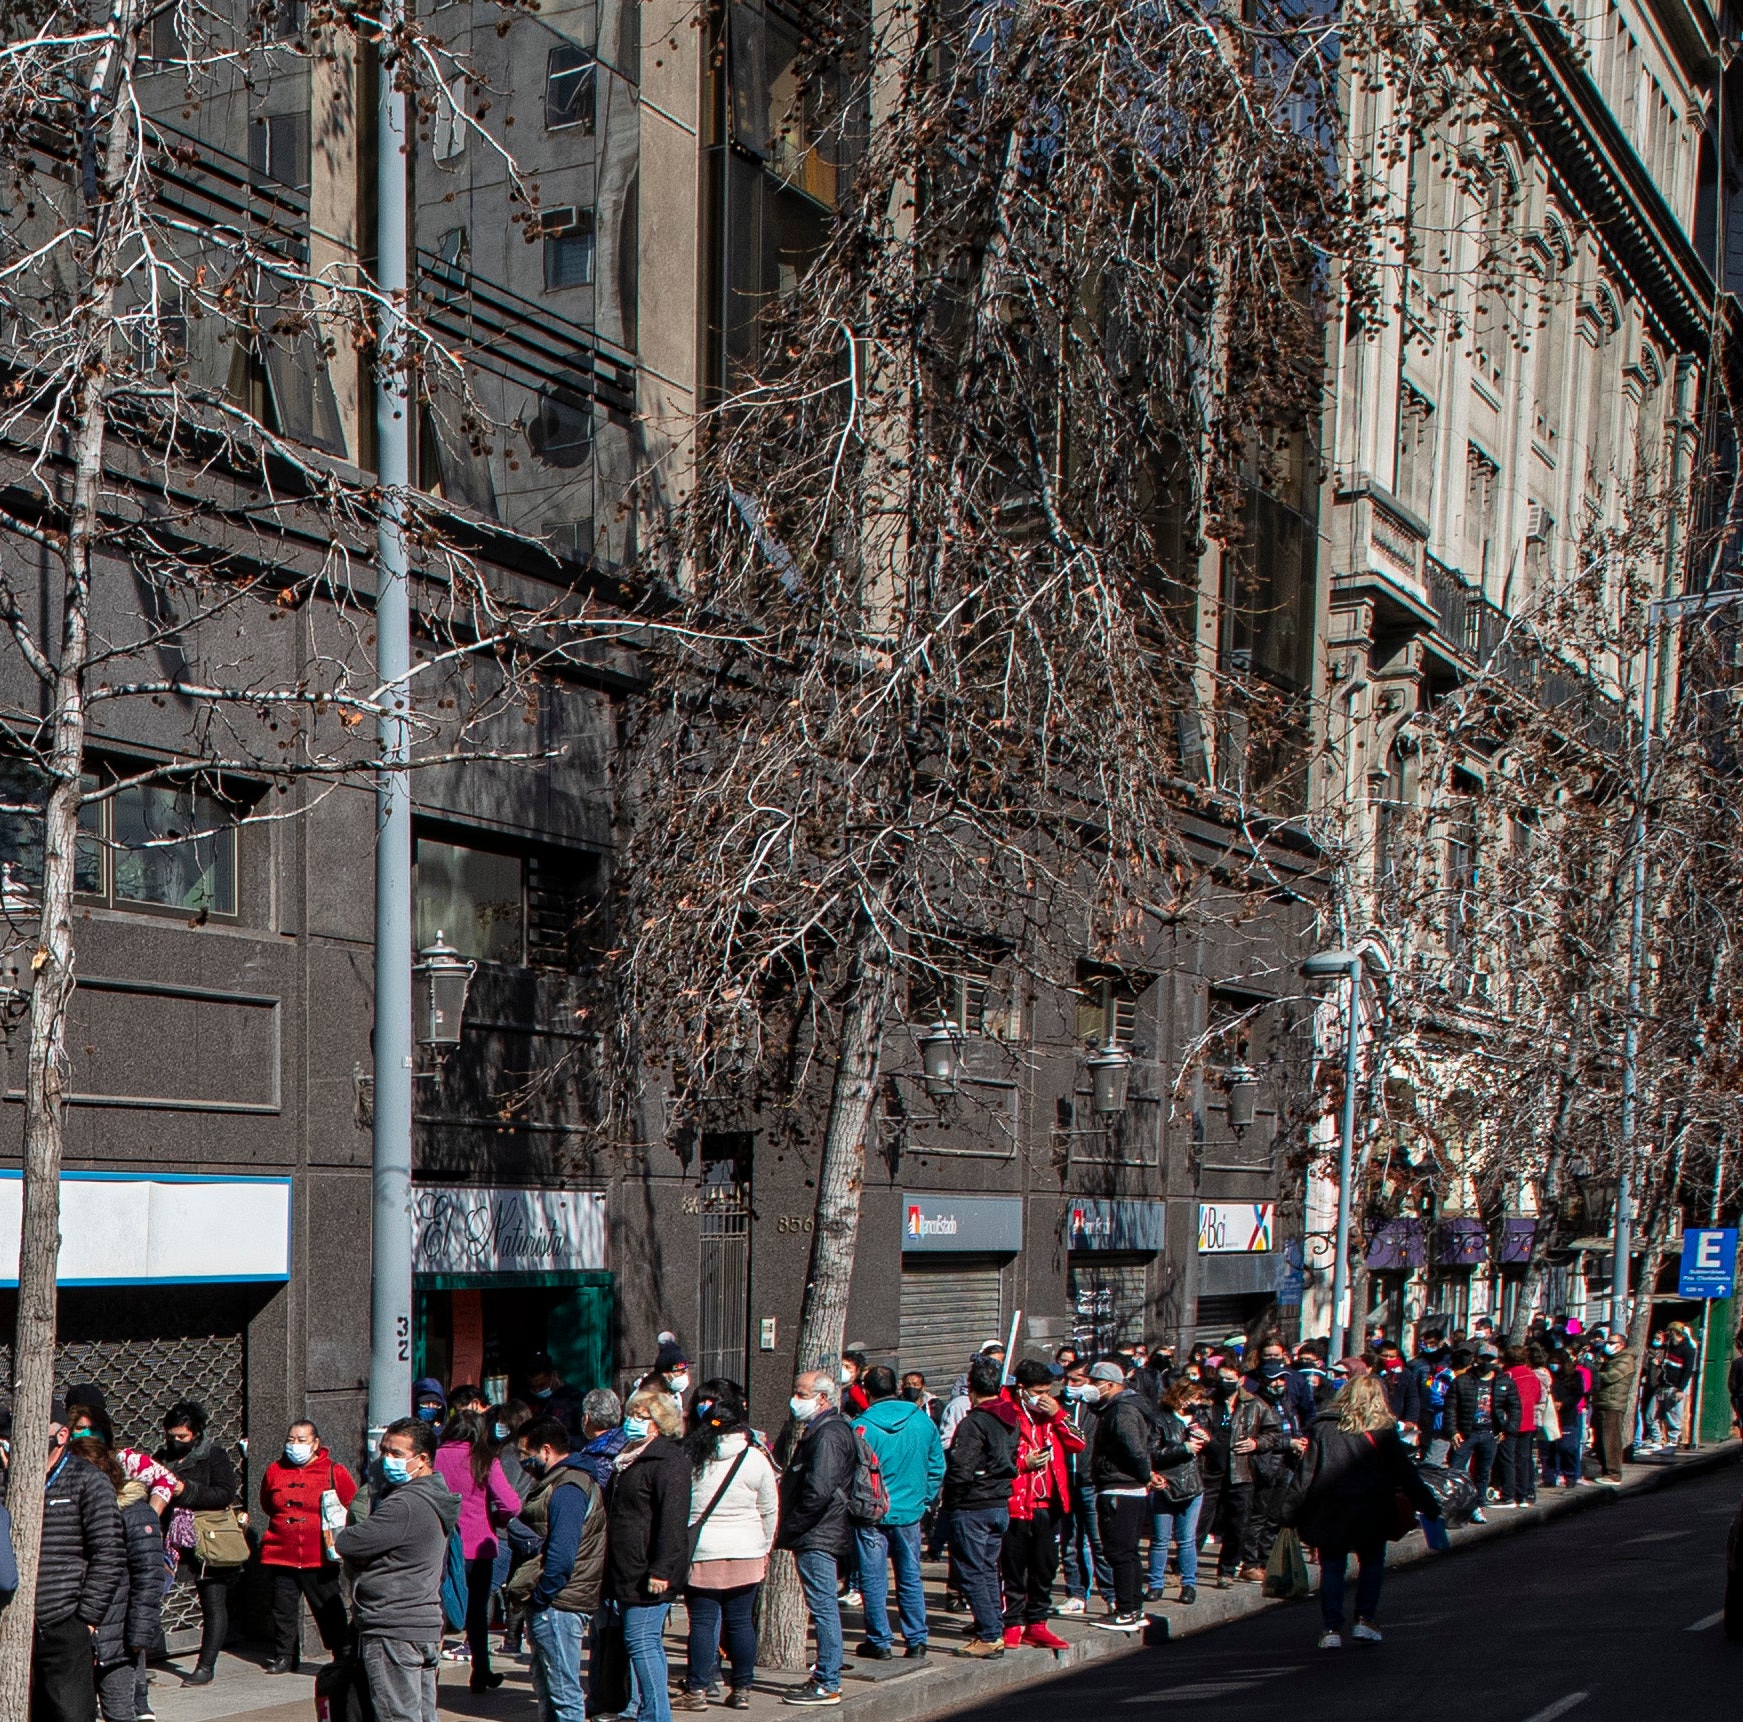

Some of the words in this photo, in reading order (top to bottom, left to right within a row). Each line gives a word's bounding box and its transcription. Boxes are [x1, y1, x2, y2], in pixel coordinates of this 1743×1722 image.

[419, 1192, 453, 1258] El
[465, 1196, 564, 1258] Naturista
[778, 1217, 814, 1234] 856
[1207, 1207, 1226, 1249] Bci
[1696, 1231, 1725, 1268] E
